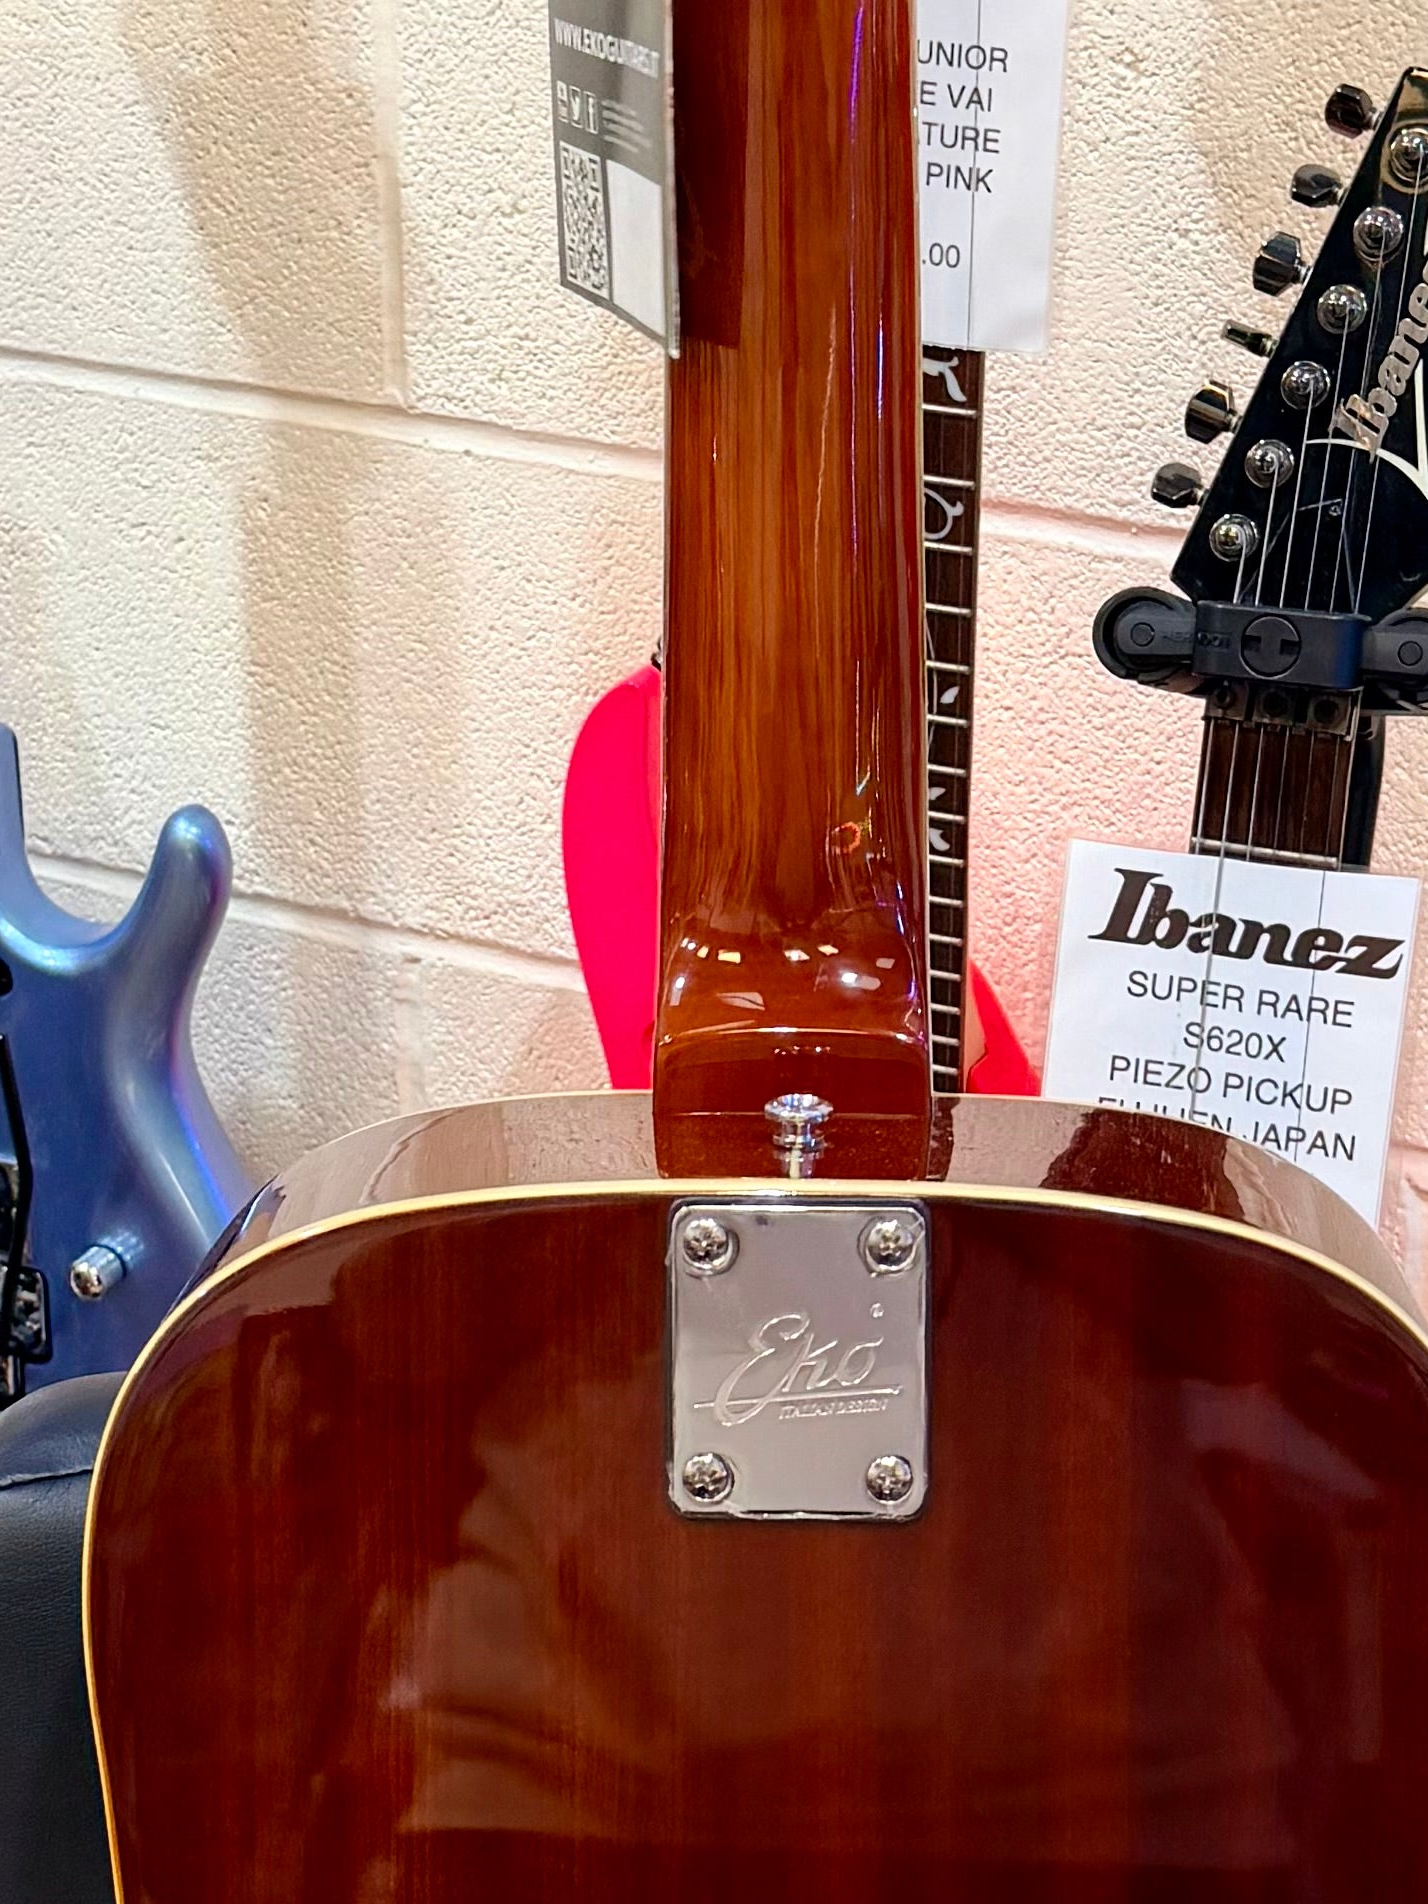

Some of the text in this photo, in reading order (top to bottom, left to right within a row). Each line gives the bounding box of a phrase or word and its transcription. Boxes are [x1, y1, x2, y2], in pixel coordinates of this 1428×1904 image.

[947, 83, 994, 114] VAI
[919, 121, 1002, 154] TURE
[926, 161, 995, 194] PINK
[1087, 867, 1406, 980] Ibanez
[1126, 969, 1356, 1028] SUPER RARE
[1183, 1021, 1288, 1064] S620X
[1109, 1054, 1212, 1094] PIEZO
[1222, 1071, 1354, 1116] PICKUP
[1242, 1120, 1357, 1162] JAPAN
